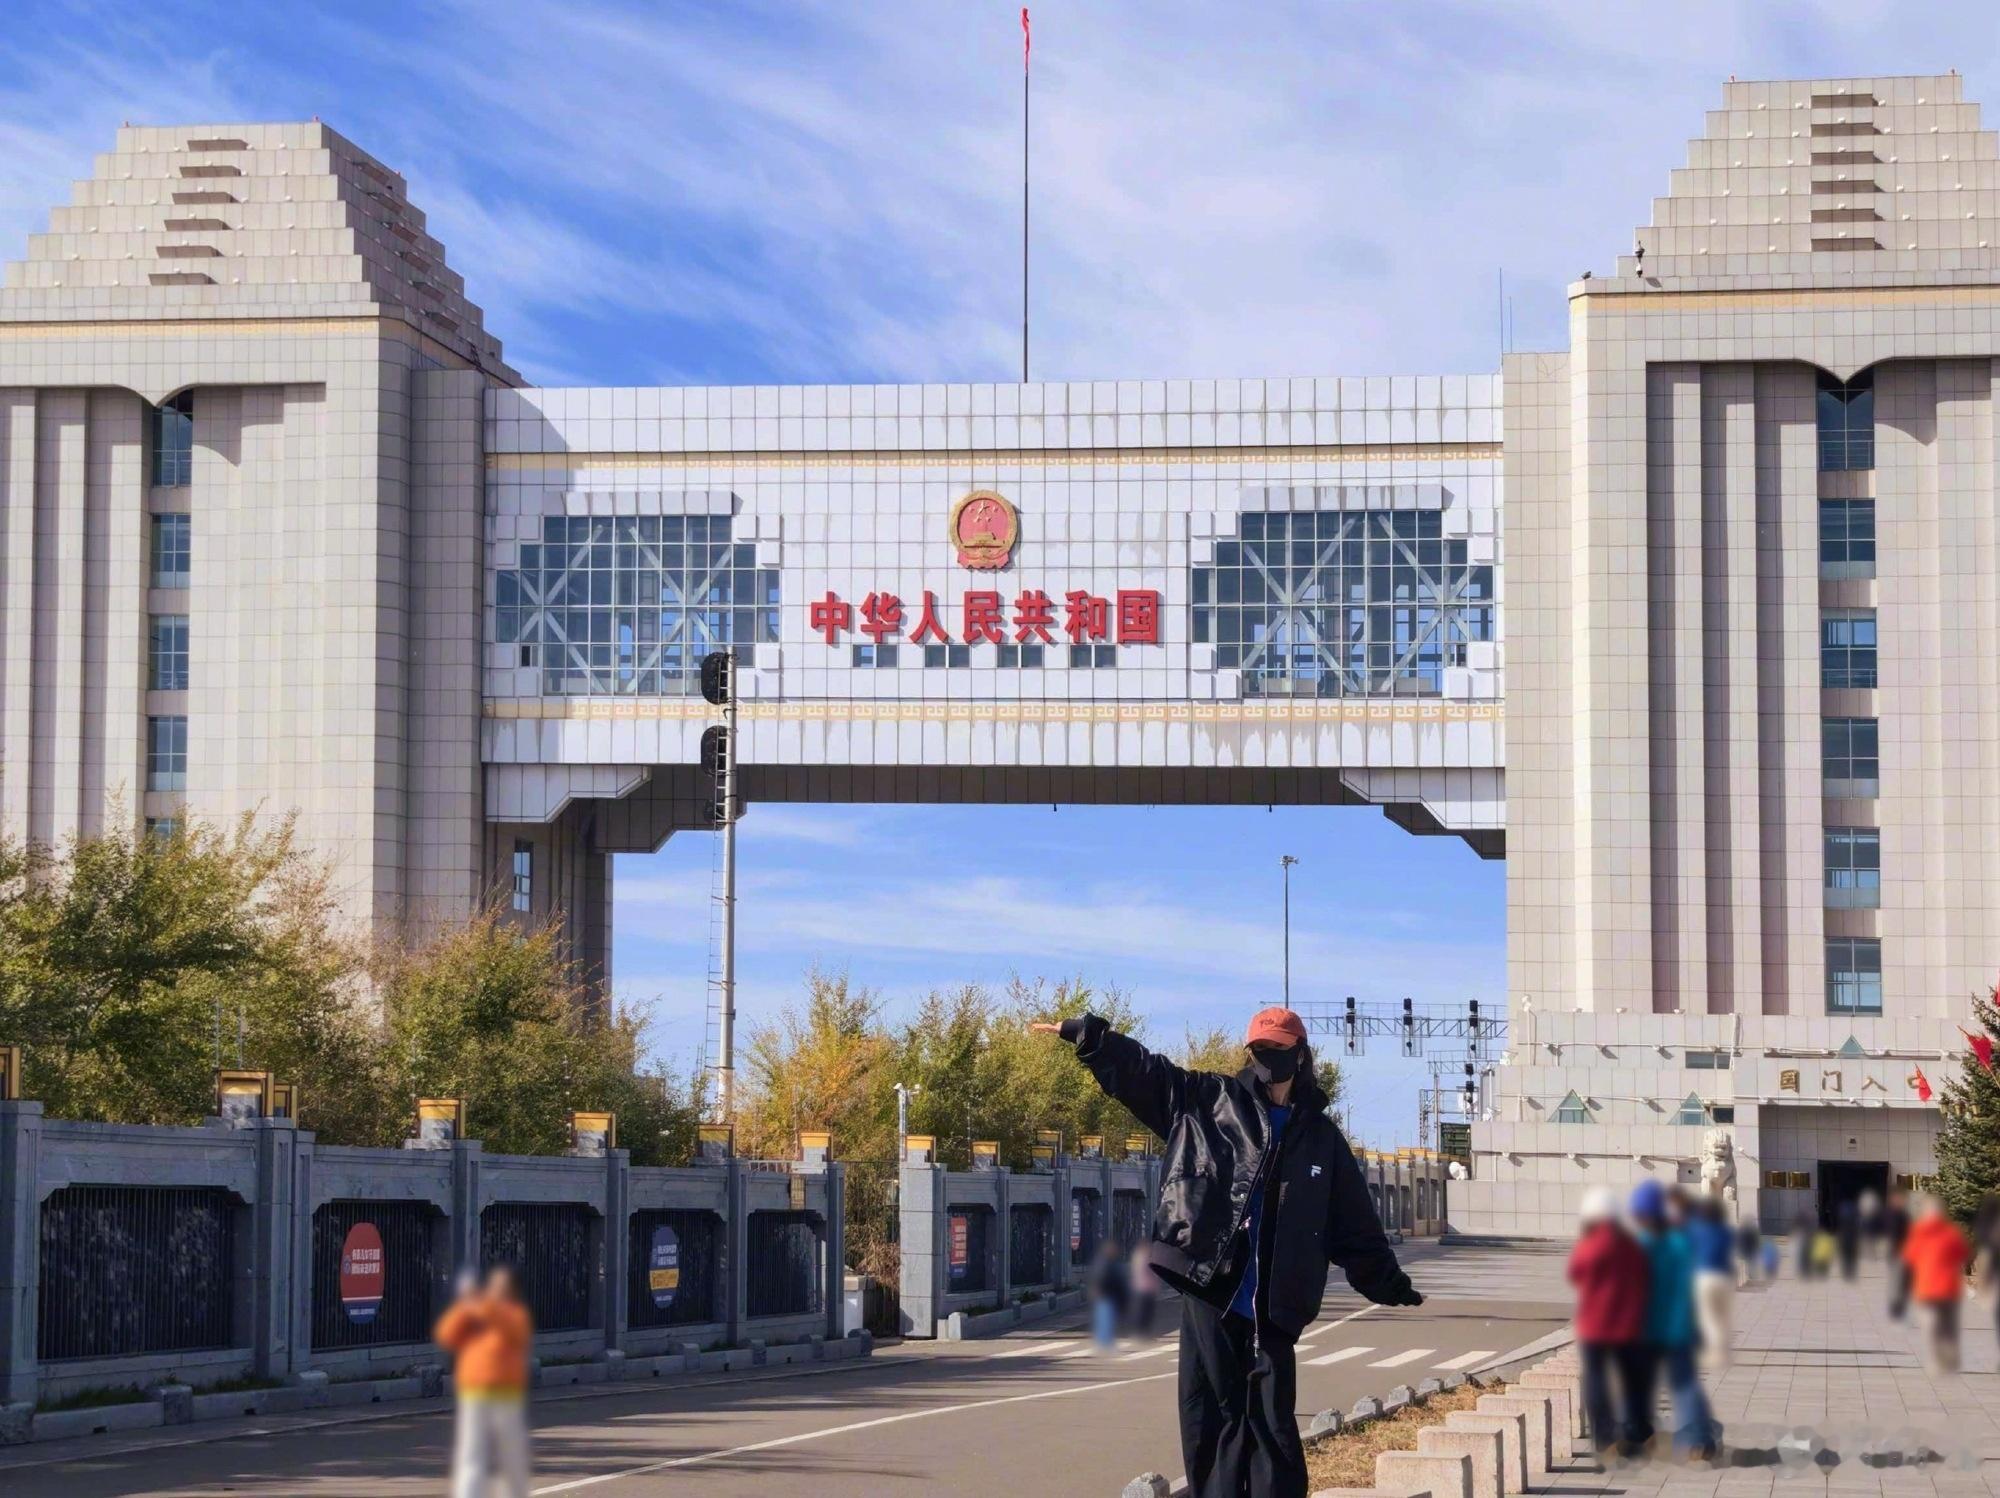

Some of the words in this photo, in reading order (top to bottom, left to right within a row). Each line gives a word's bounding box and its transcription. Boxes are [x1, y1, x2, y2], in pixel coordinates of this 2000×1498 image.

[810, 589, 1159, 645] 中华人民共和国
